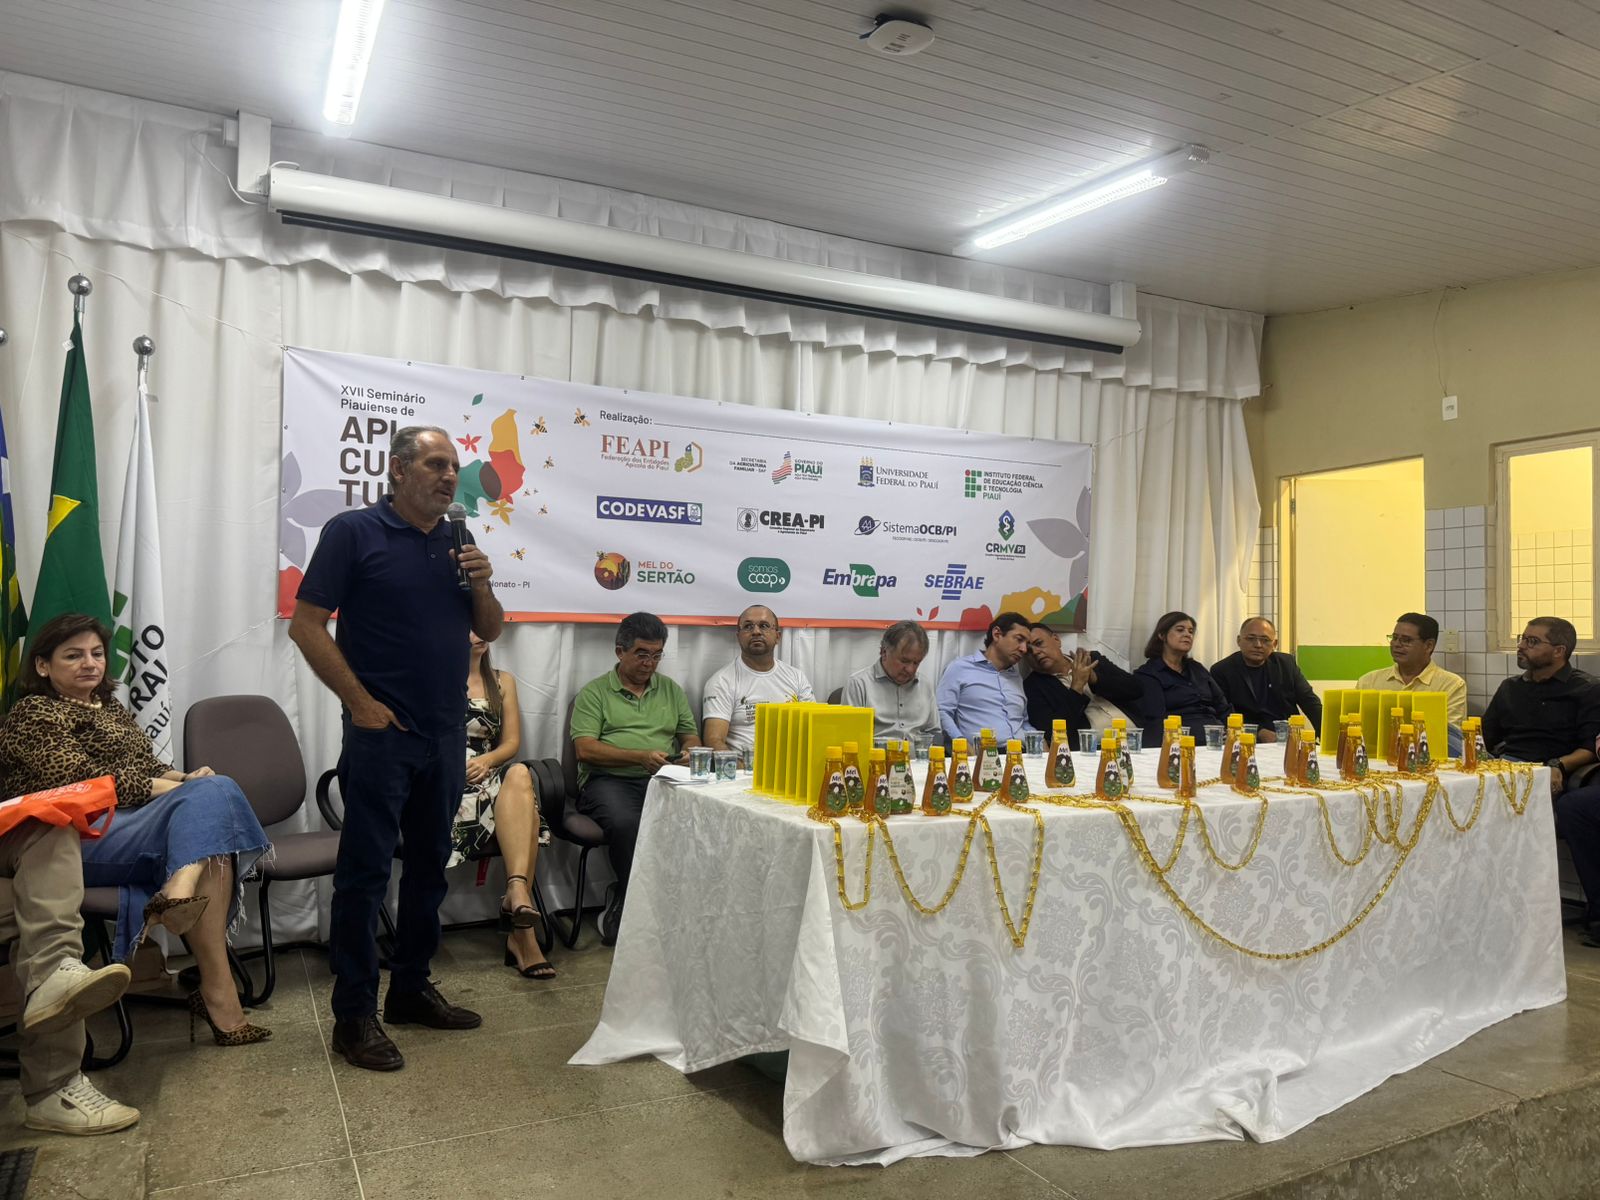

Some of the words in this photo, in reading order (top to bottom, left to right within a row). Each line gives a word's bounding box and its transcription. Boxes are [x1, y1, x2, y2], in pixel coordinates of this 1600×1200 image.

[341, 385, 364, 397] XVII
[367, 388, 426, 404] Seminário
[341, 398, 398, 415] Piauiense
[400, 406, 415, 416] de
[600, 410, 653, 425] Realização:
[601, 434, 671, 459] FEAPI
[340, 447, 386, 476] CU
[984, 471, 1011, 479] INSTITUTO
[1012, 473, 1036, 482] FEDERAL
[992, 479, 1022, 488] EDUCAÇÃO
[1022, 480, 1044, 489] CIÊNCIA
[988, 485, 1023, 494] TECNOLOGIA
[599, 500, 686, 520] CODEVASF
[759, 510, 825, 529] CREA-PI
[882, 521, 957, 537] SistemaOCB/PI
[638, 561, 658, 569] MEL
[660, 562, 674, 570] DO
[748, 564, 778, 574] somos
[636, 569, 695, 585] SERTÃO
[748, 573, 778, 588] coop
[822, 568, 897, 590] Embrapa
[924, 574, 985, 590] SEBRAE
